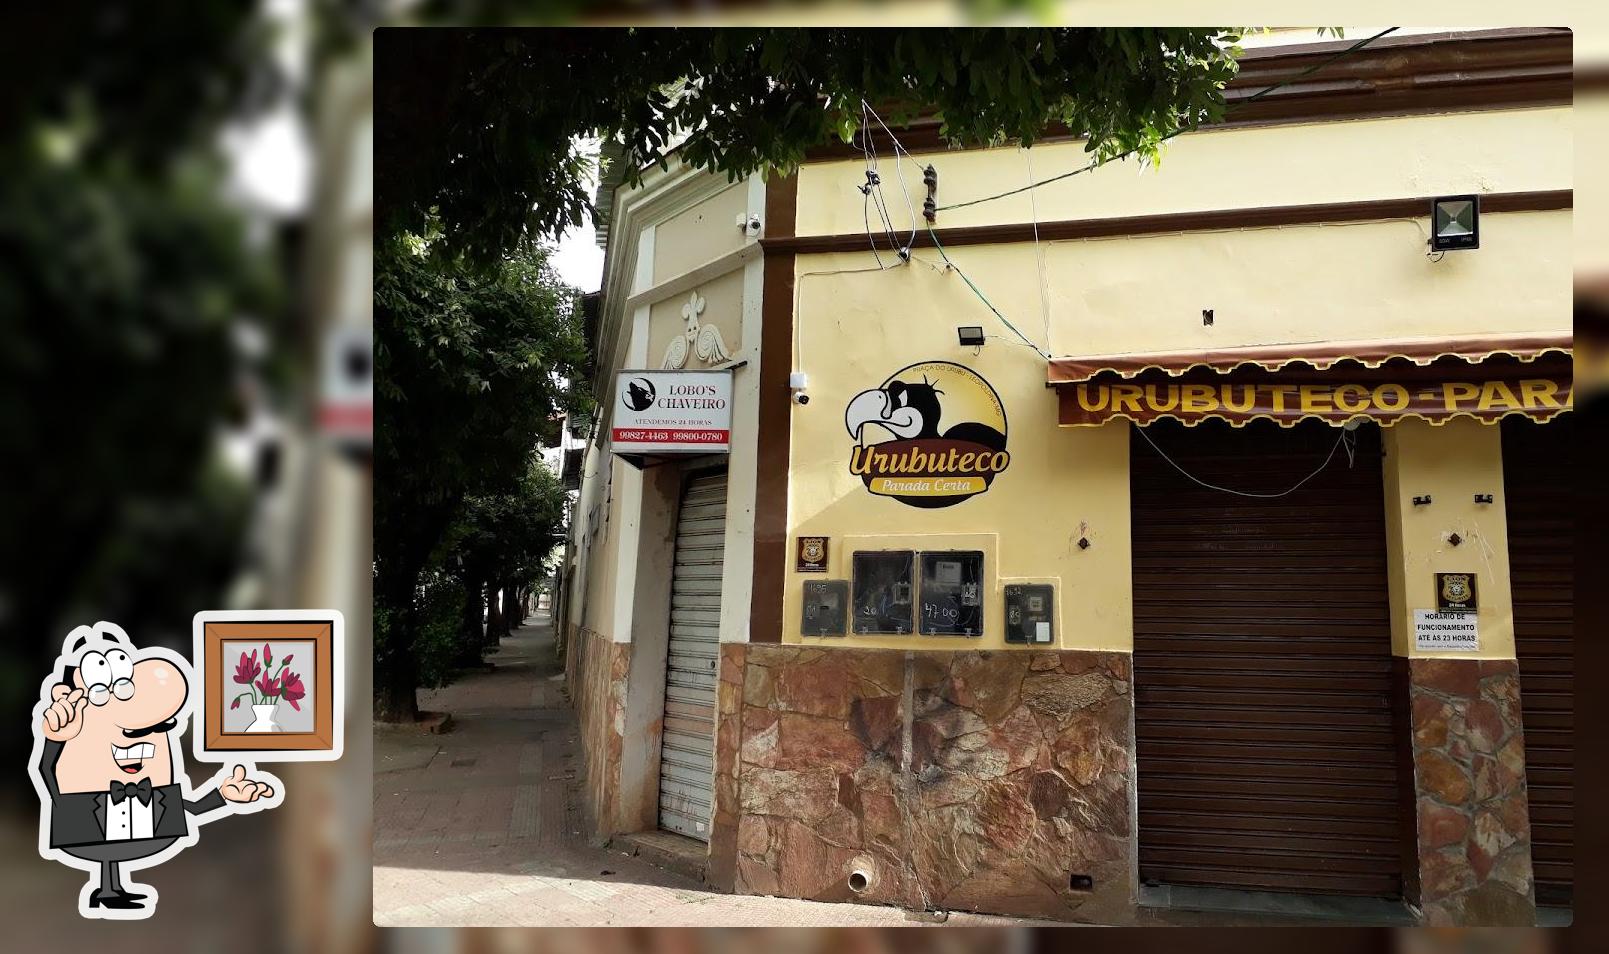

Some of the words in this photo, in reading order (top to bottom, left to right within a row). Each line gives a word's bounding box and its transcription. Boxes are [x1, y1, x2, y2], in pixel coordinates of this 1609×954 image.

[669, 385, 716, 396] LOBO'S
[1077, 383, 1410, 413] URUBUTECO
[1442, 379, 1573, 411] PAR
[657, 398, 726, 410] CHAVEIRO
[619, 431, 669, 440] 99827-4463
[672, 432, 723, 441] 99800-0780
[851, 446, 1010, 474] Urubuteco
[882, 479, 930, 492] Parada
[934, 479, 970, 491] Certa
[1452, 634, 1476, 642] HORAS
